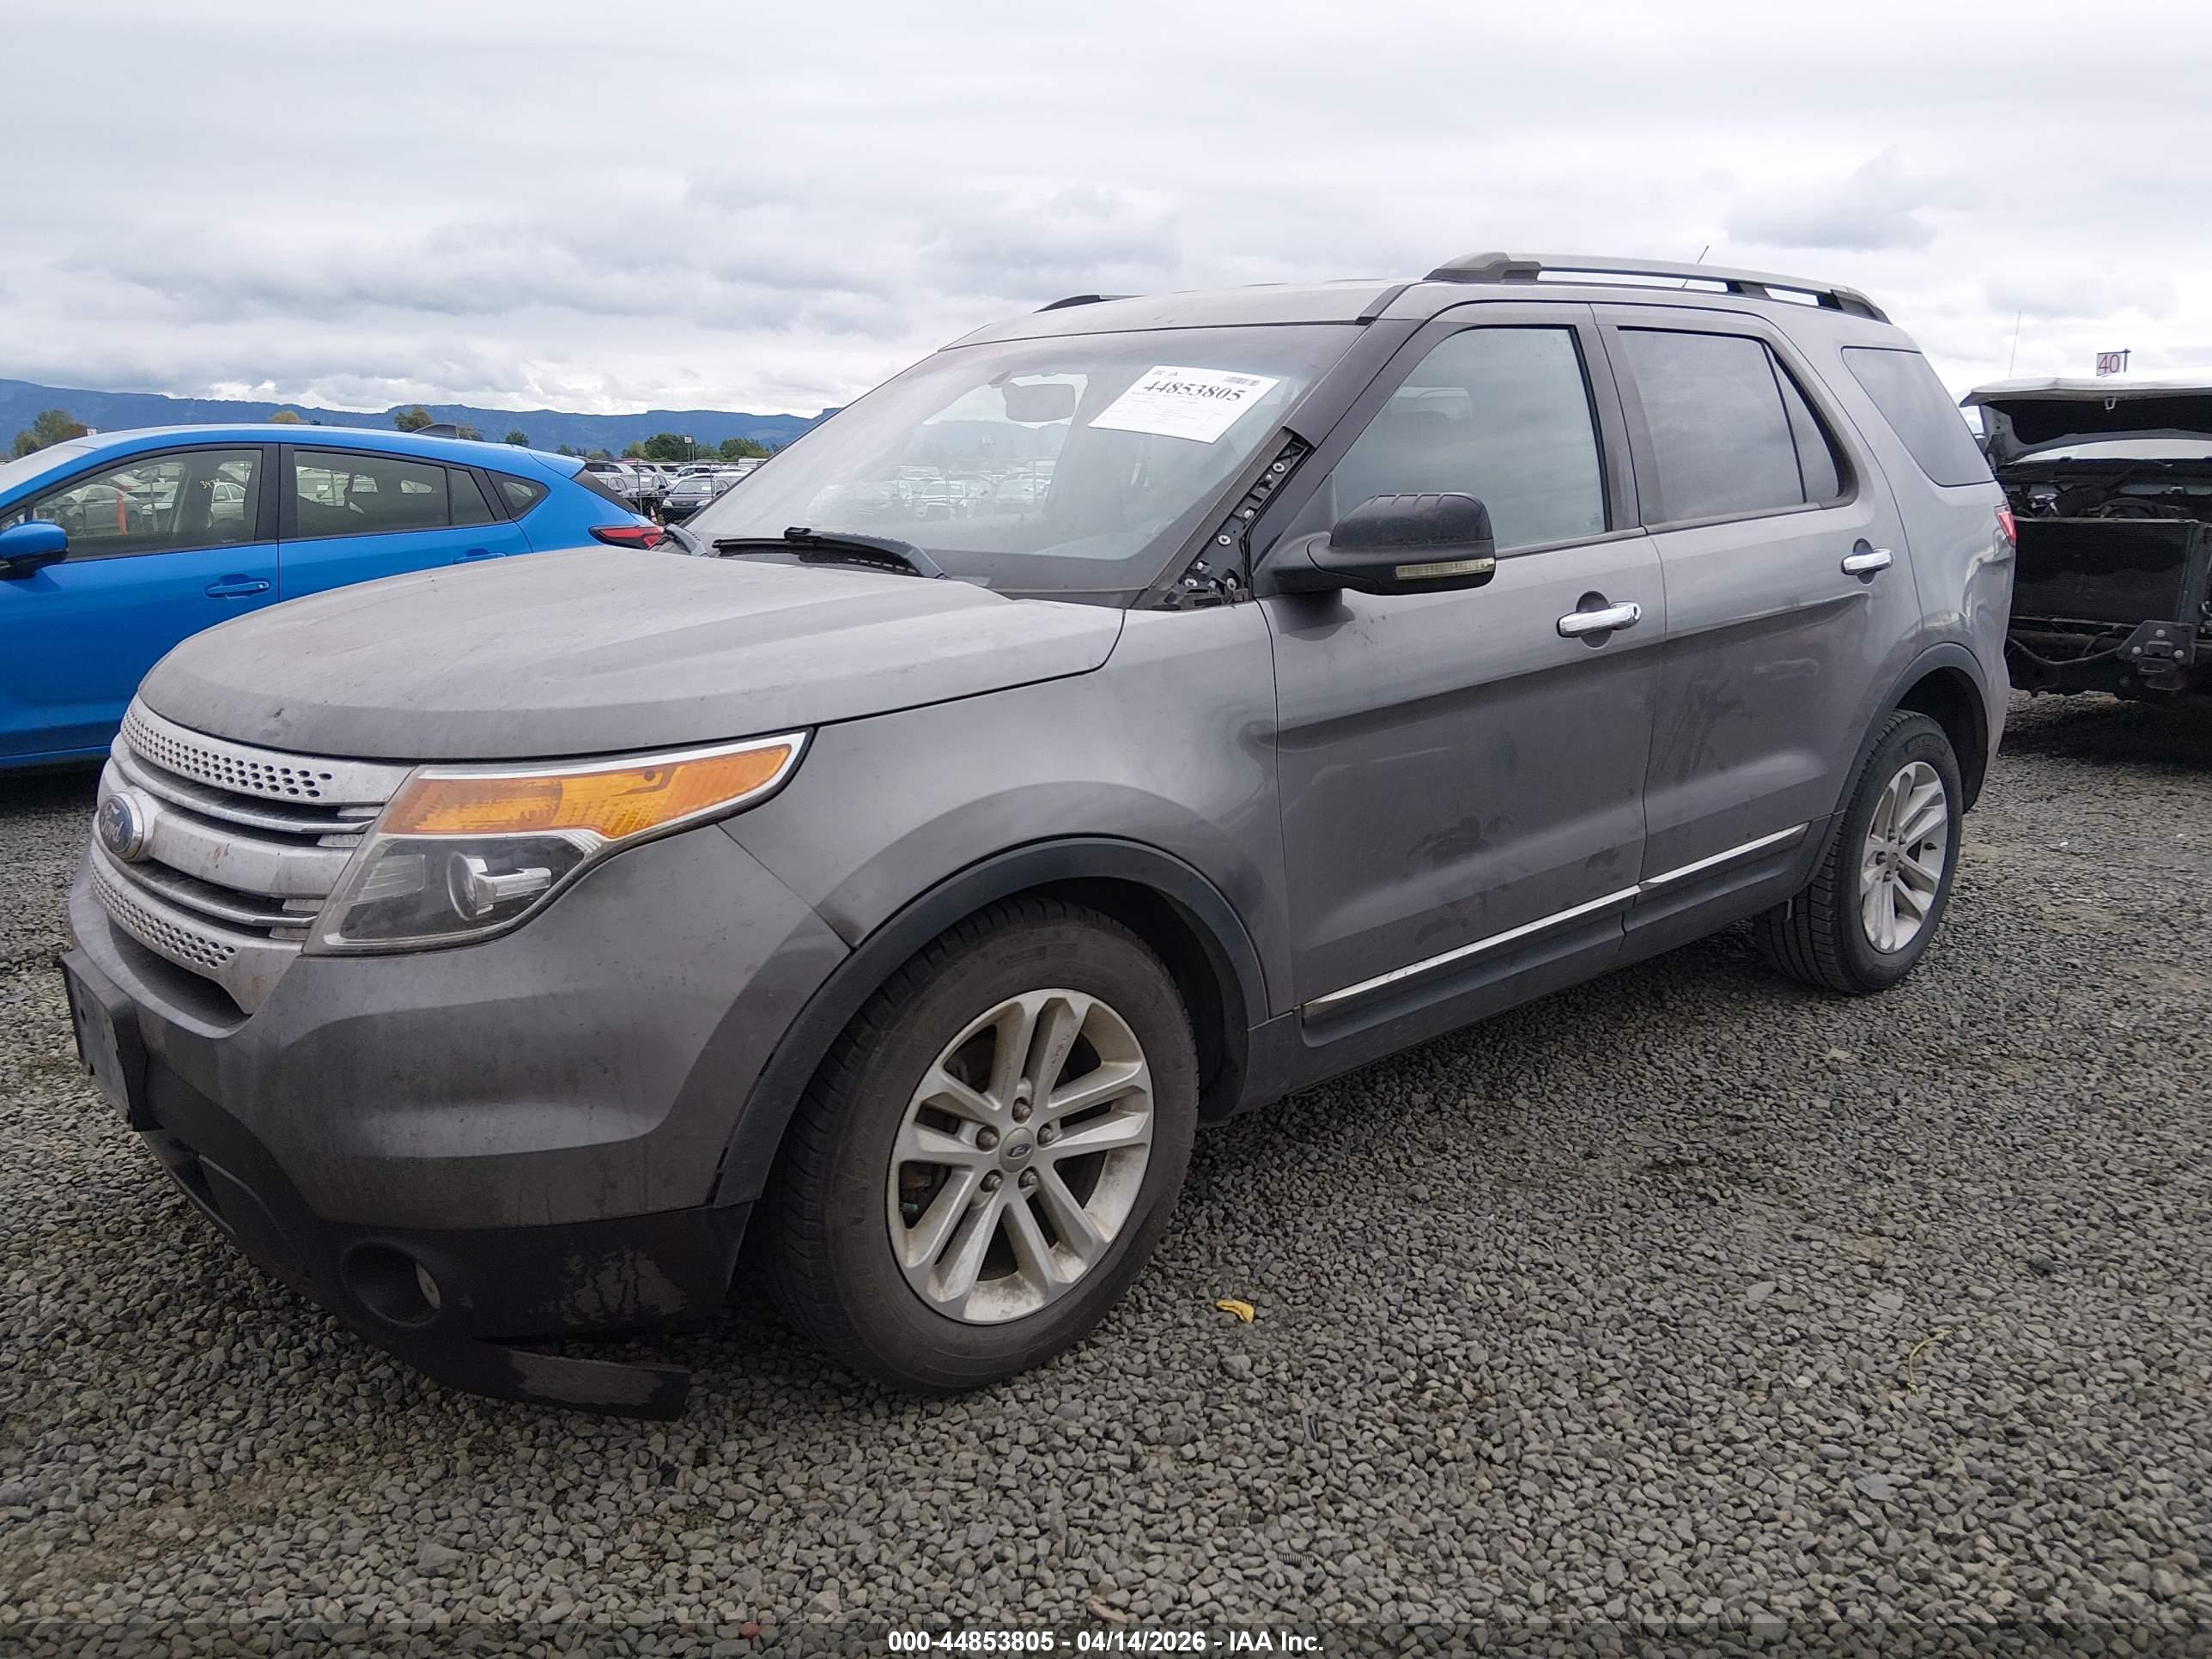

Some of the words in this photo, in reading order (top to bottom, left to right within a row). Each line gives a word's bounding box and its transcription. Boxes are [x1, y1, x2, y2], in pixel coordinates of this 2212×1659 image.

[2098, 354, 2120, 374] 40
[1143, 380, 1248, 402] 44853805
[100, 802, 125, 843] Ford
